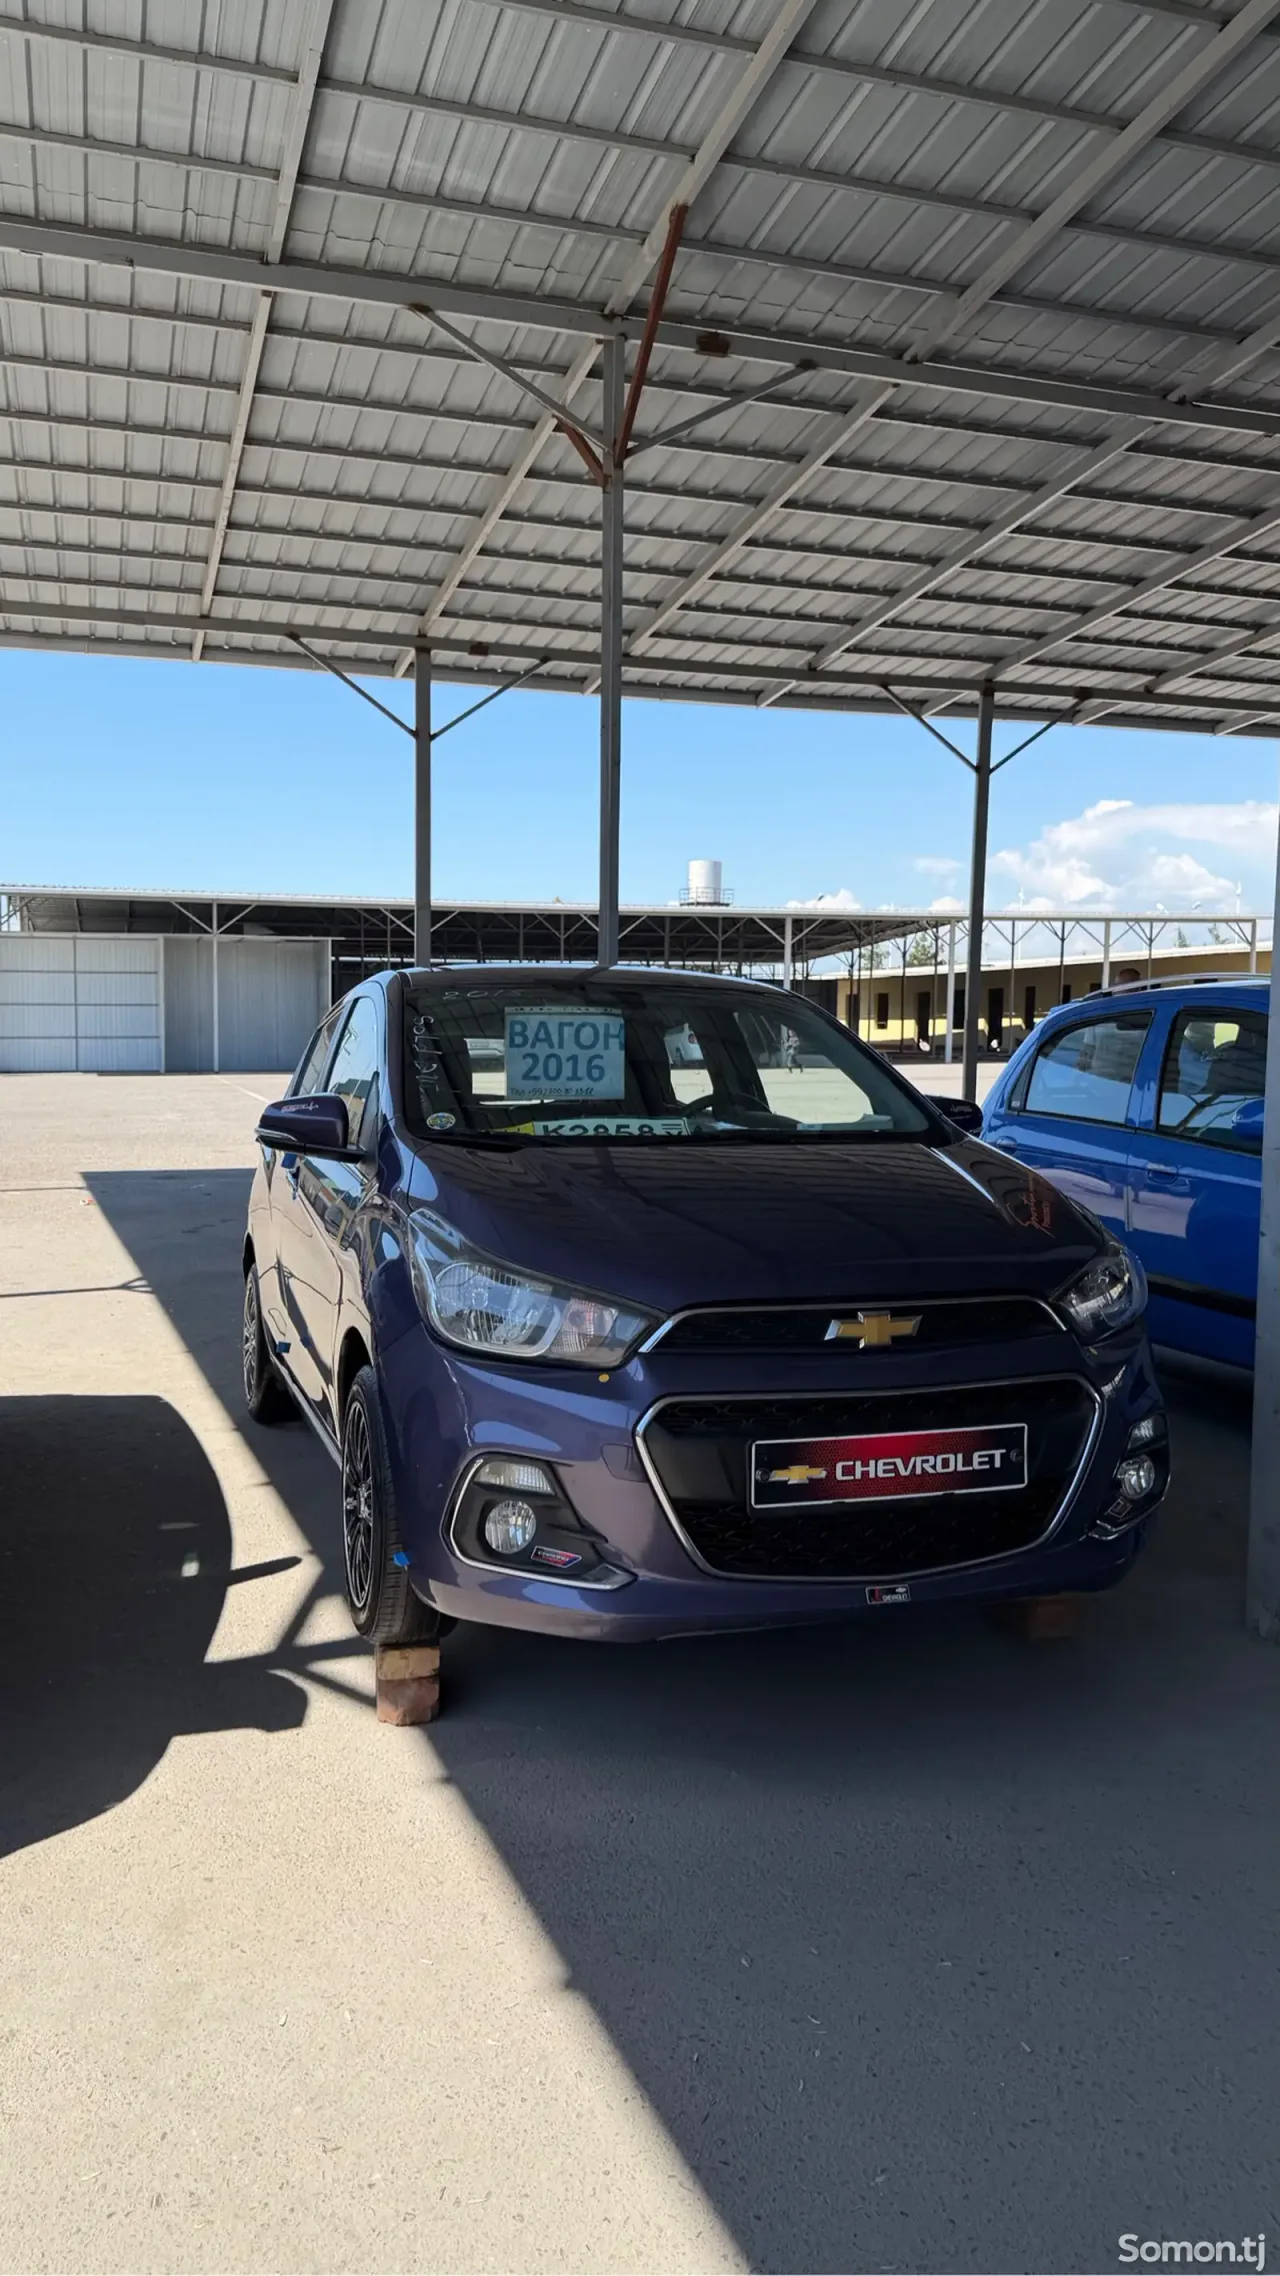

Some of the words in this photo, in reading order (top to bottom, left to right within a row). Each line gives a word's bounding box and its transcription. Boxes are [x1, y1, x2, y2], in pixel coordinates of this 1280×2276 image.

[509, 1020, 625, 1051] ВАГОН
[521, 1052, 605, 1082] 2016
[835, 1449, 1006, 1481] CHEVROLET
